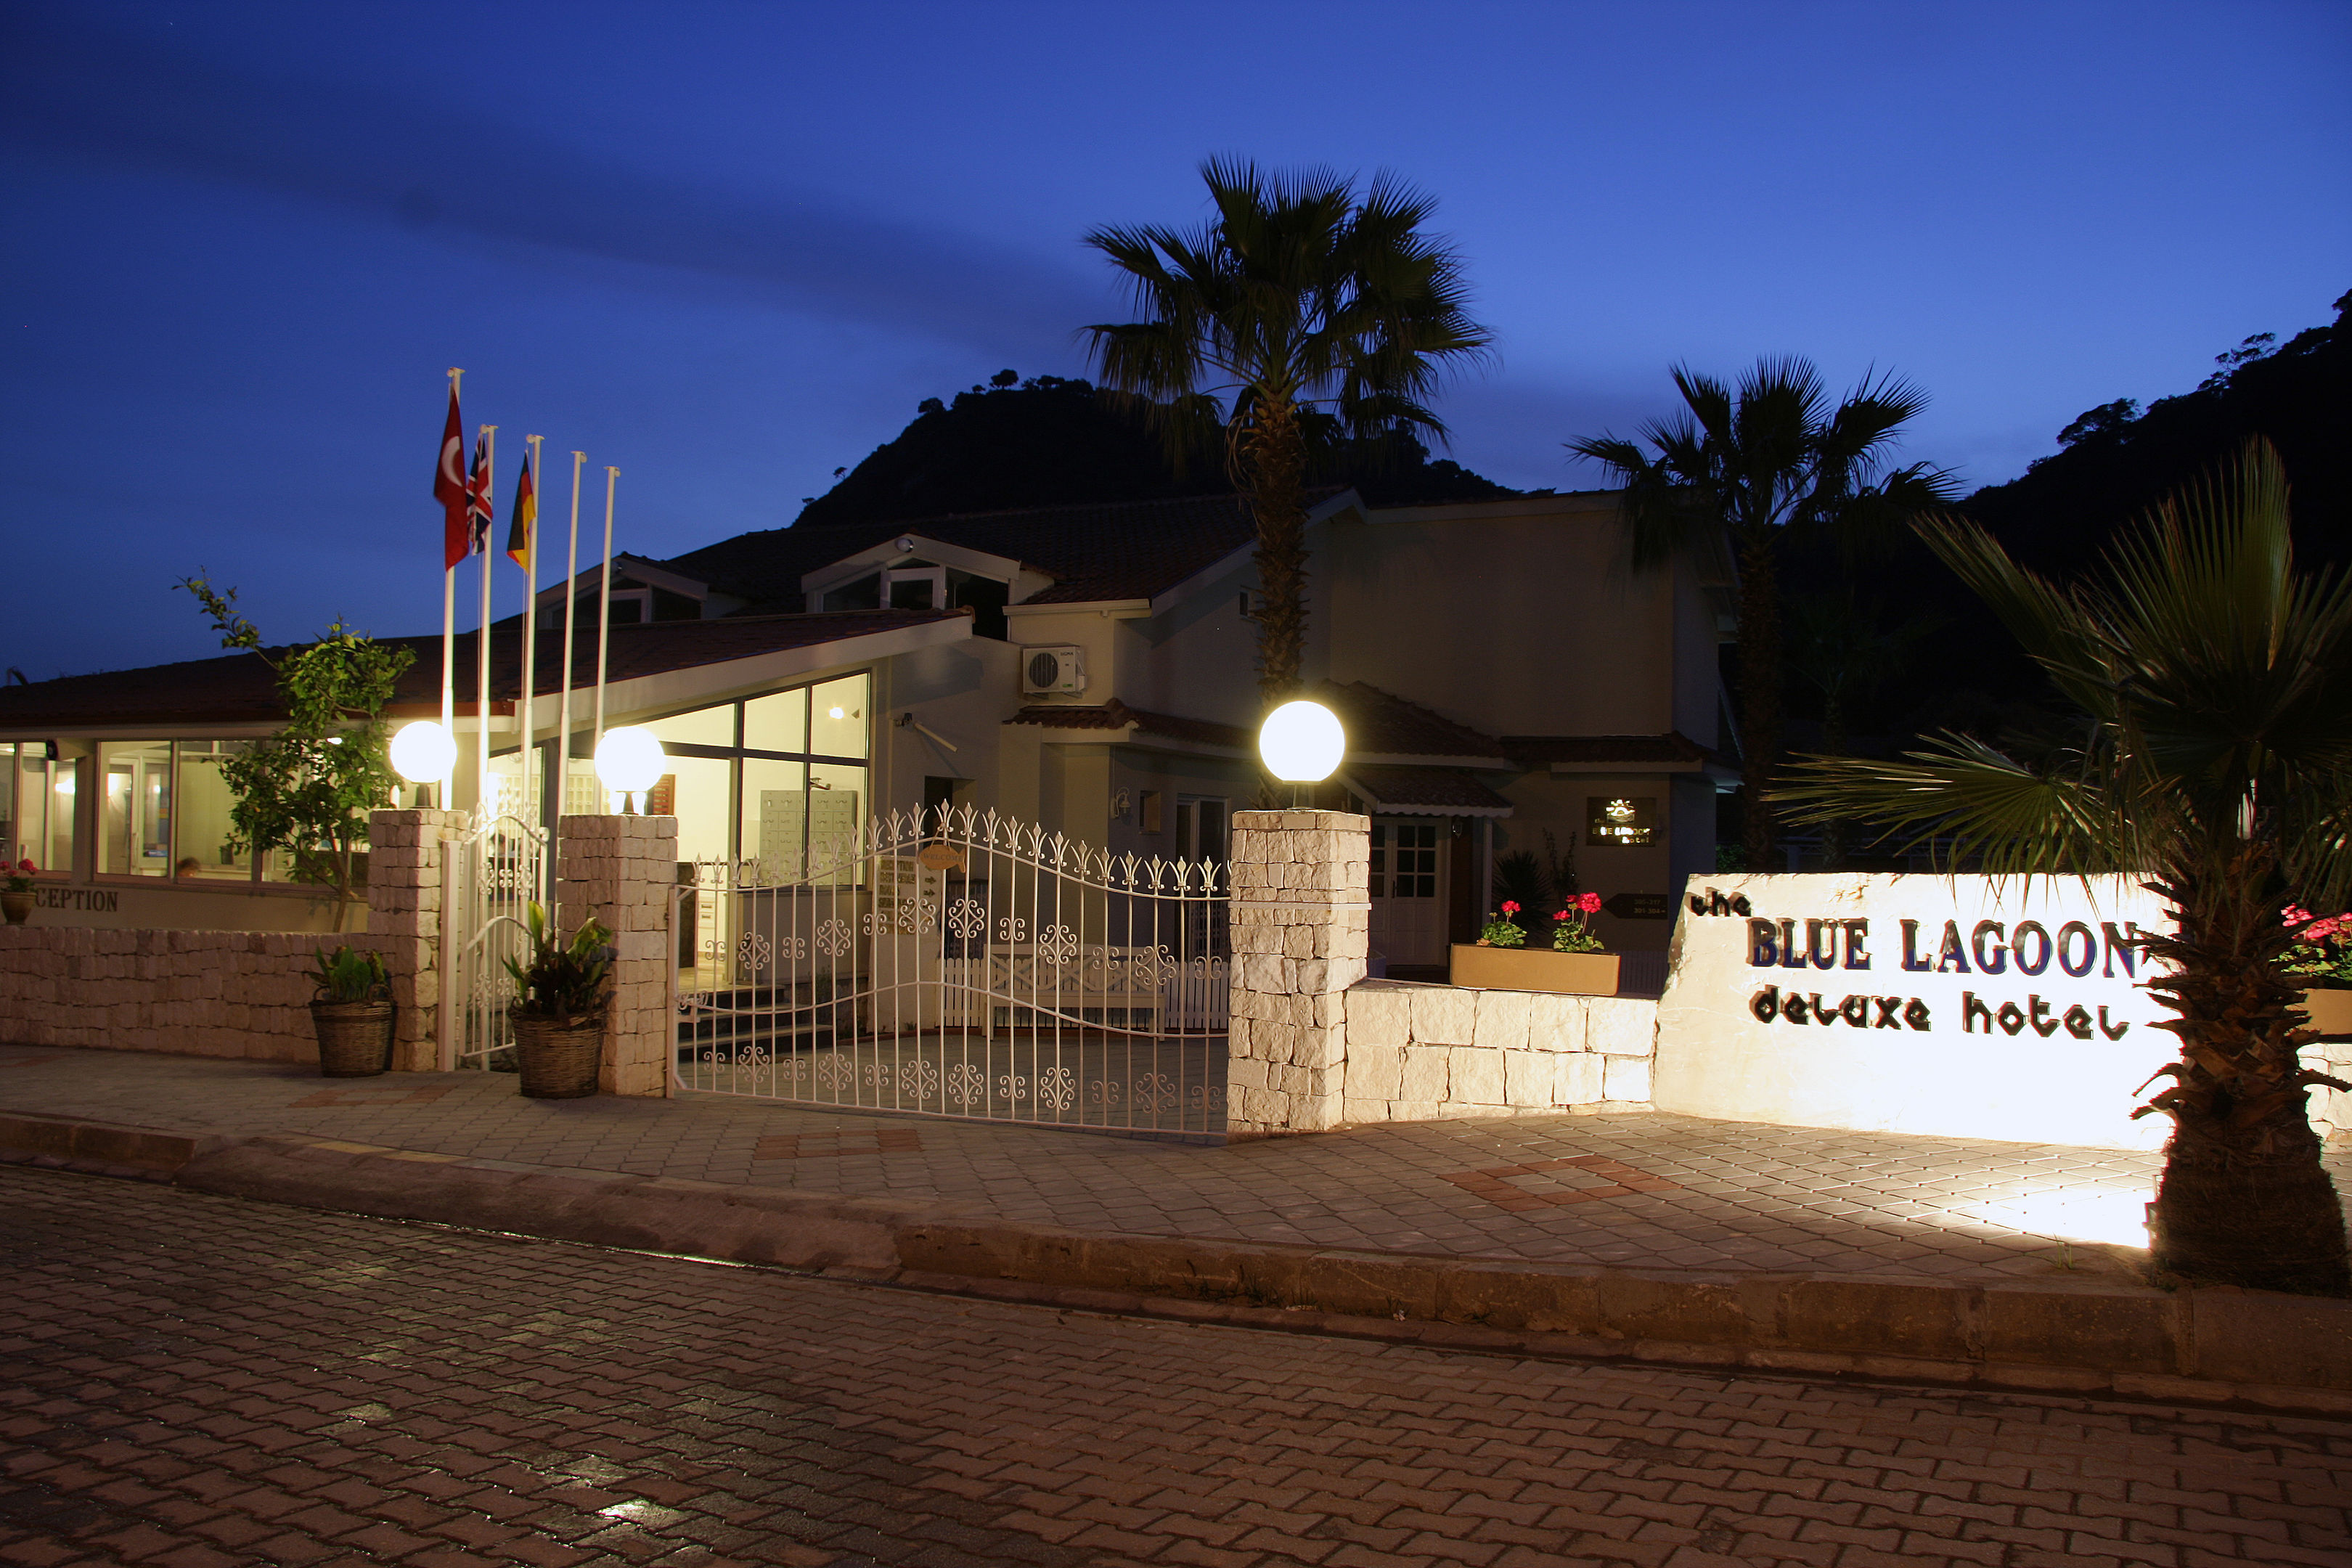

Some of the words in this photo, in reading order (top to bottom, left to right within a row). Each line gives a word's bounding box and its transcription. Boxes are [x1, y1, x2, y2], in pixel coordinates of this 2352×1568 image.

[1592, 826, 1613, 836] BE
[923, 853, 963, 862] WELCOME
[36, 888, 119, 912] CEPTION
[1685, 887, 1752, 917] the
[1746, 917, 1872, 970] BLUE
[1900, 919, 2138, 979] LAGOON
[1962, 991, 2131, 1041] hotel
